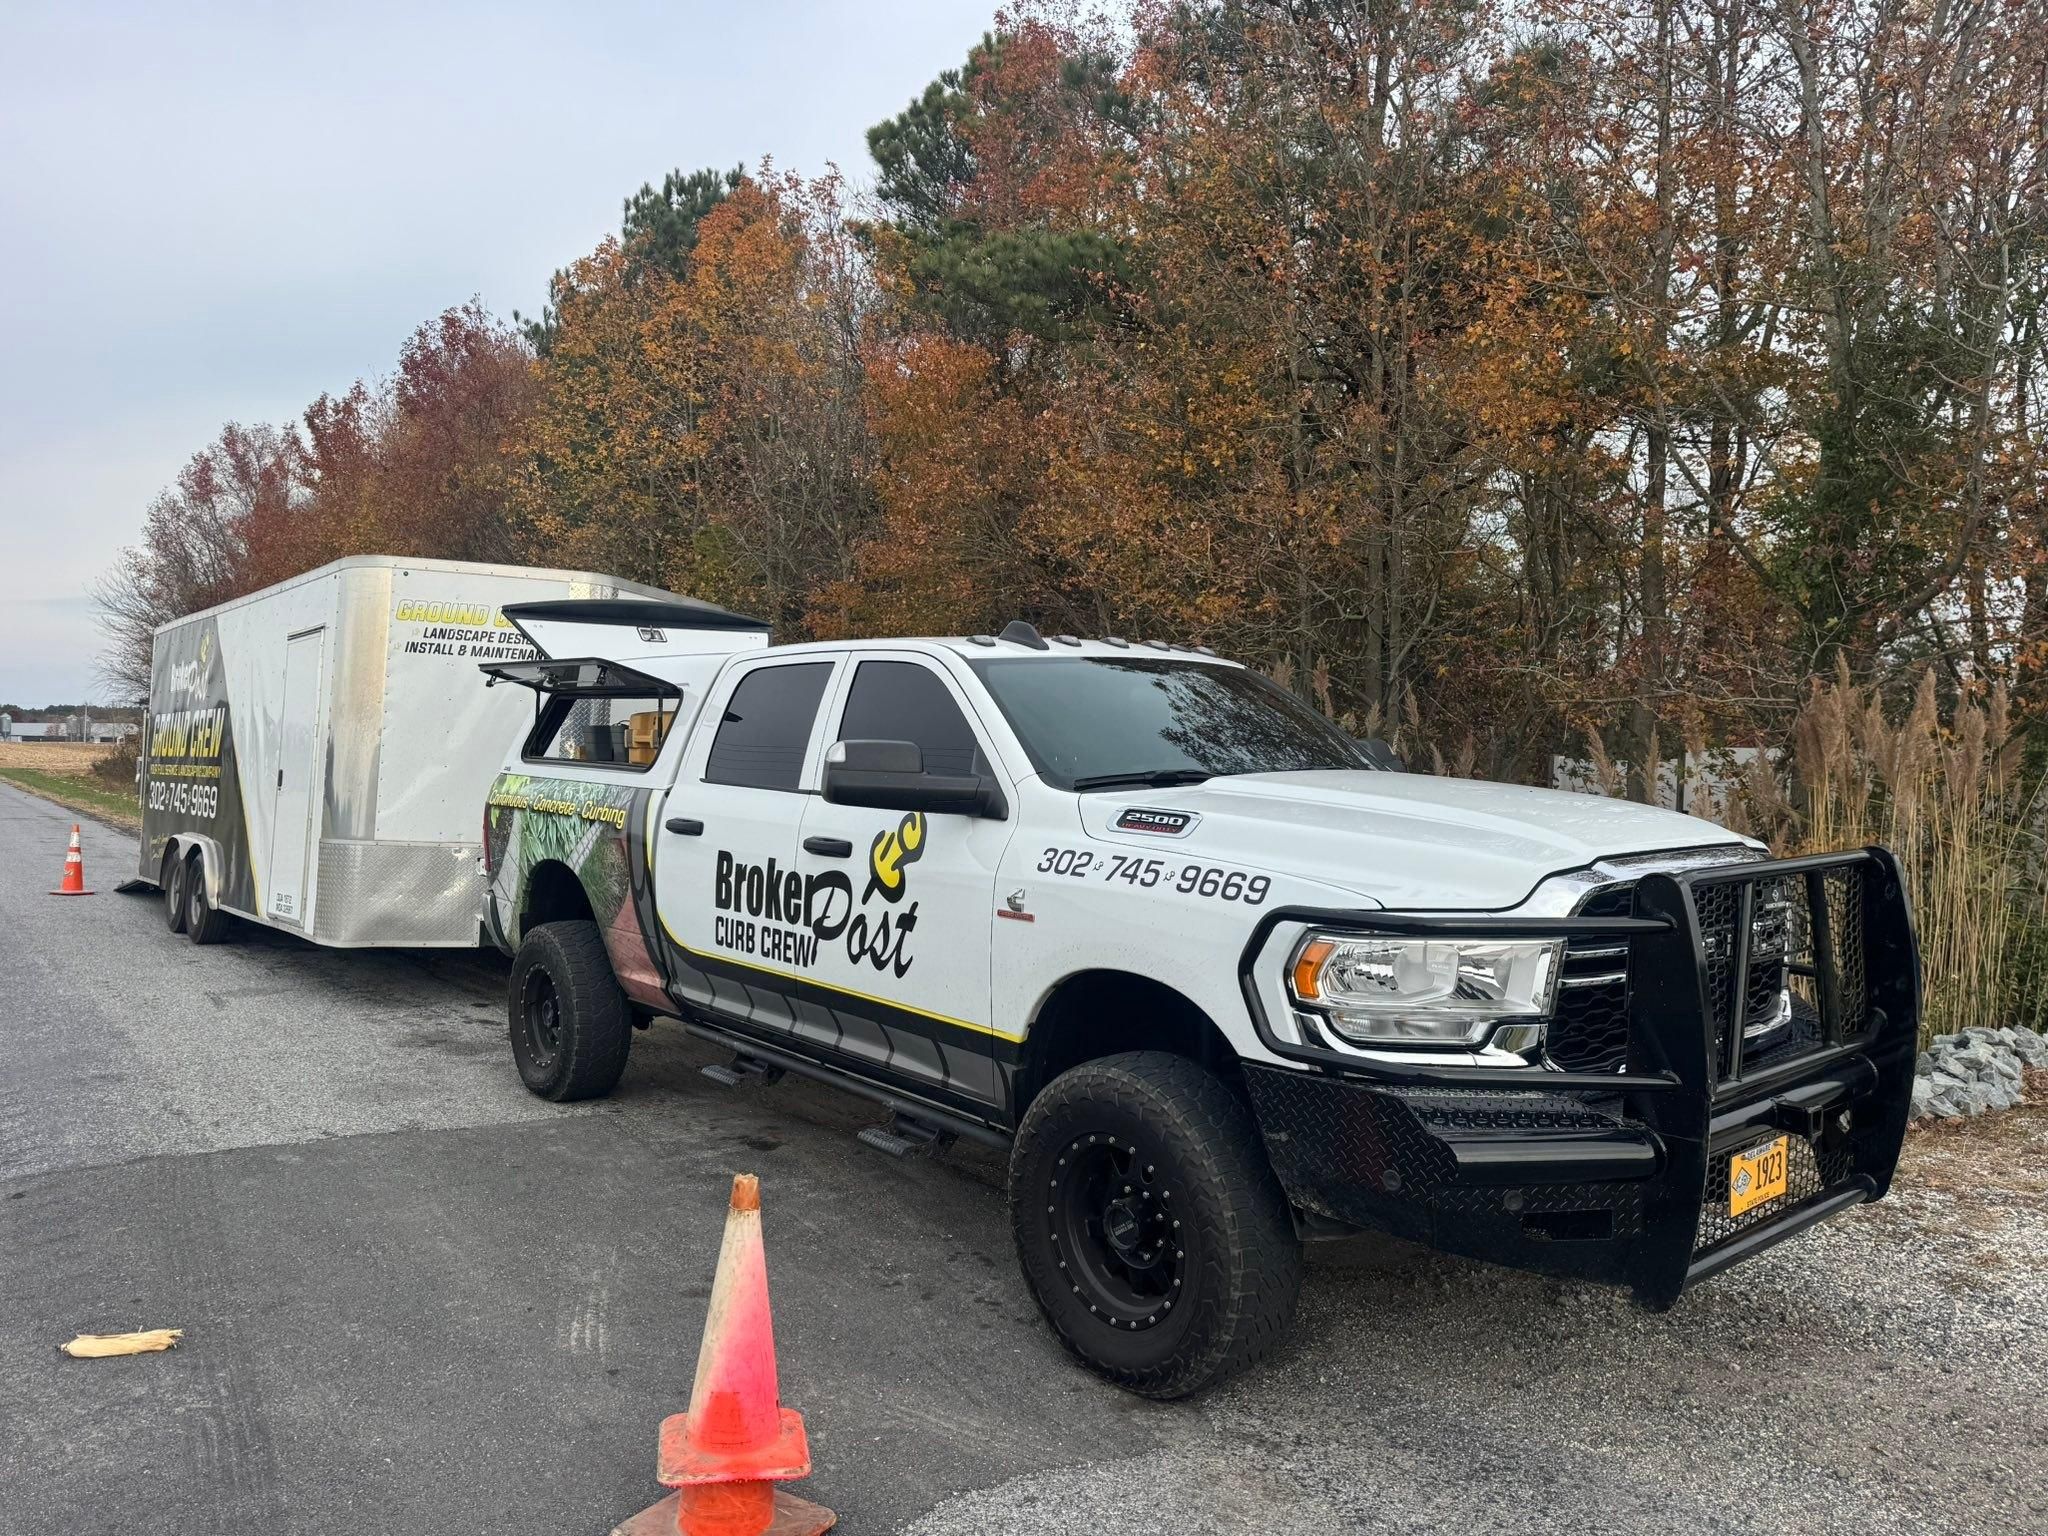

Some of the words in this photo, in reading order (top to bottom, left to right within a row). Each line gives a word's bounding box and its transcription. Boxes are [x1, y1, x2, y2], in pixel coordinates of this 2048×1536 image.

[396, 599, 490, 626] GROUND
[405, 641, 454, 656] INSTALL
[458, 645, 467, 656] &
[423, 627, 496, 643] LANDSCAPE
[151, 710, 191, 757] GROUND
[190, 707, 225, 758] CREW
[149, 781, 166, 811] 302
[169, 782, 188, 814] 745
[191, 784, 218, 819] 9669
[489, 789, 529, 808] Continuous
[533, 794, 576, 815] Concrete
[582, 800, 626, 830] Curbing
[1126, 812, 1183, 826] 2500
[1037, 848, 1094, 877] 302
[1105, 855, 1165, 887] 745
[1176, 865, 1272, 905] 9669
[715, 850, 816, 927] Broker
[811, 870, 919, 979] Post
[715, 916, 755, 954] CURB
[761, 926, 812, 968] CREW
[1756, 1151, 1782, 1190] 1923
